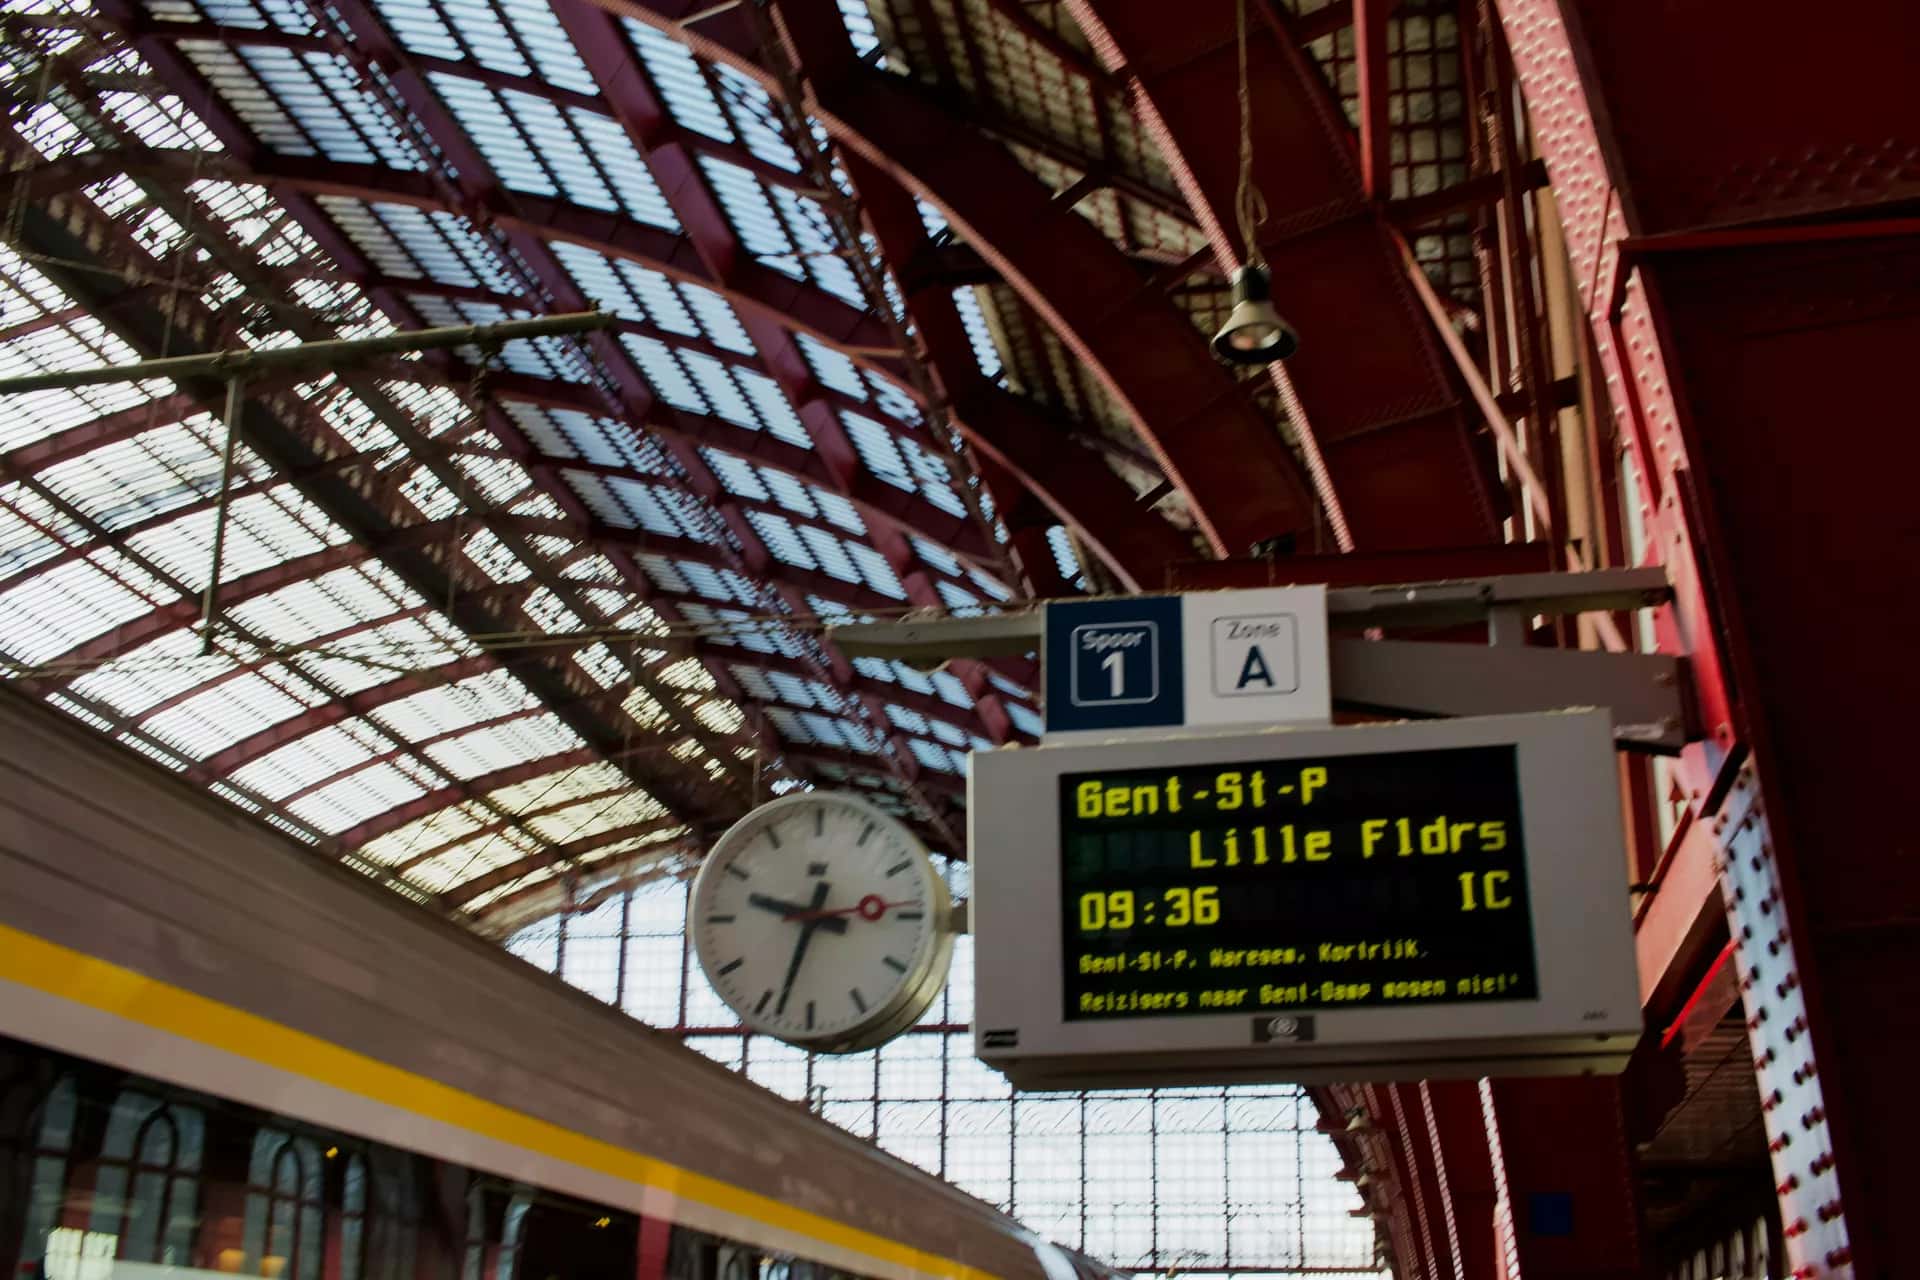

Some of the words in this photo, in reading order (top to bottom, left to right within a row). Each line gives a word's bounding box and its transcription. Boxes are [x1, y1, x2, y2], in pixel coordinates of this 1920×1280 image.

[1081, 630, 1147, 652] Spoor
[1226, 621, 1281, 640] Zone
[1101, 651, 1125, 697] 1
[1235, 644, 1275, 689] A
[1077, 766, 1328, 818] Gent-St-P
[1189, 824, 1332, 869] Lille
[1361, 815, 1506, 858] Fldrs
[1079, 886, 1220, 930] 09:36
[1459, 870, 1511, 911] IC
